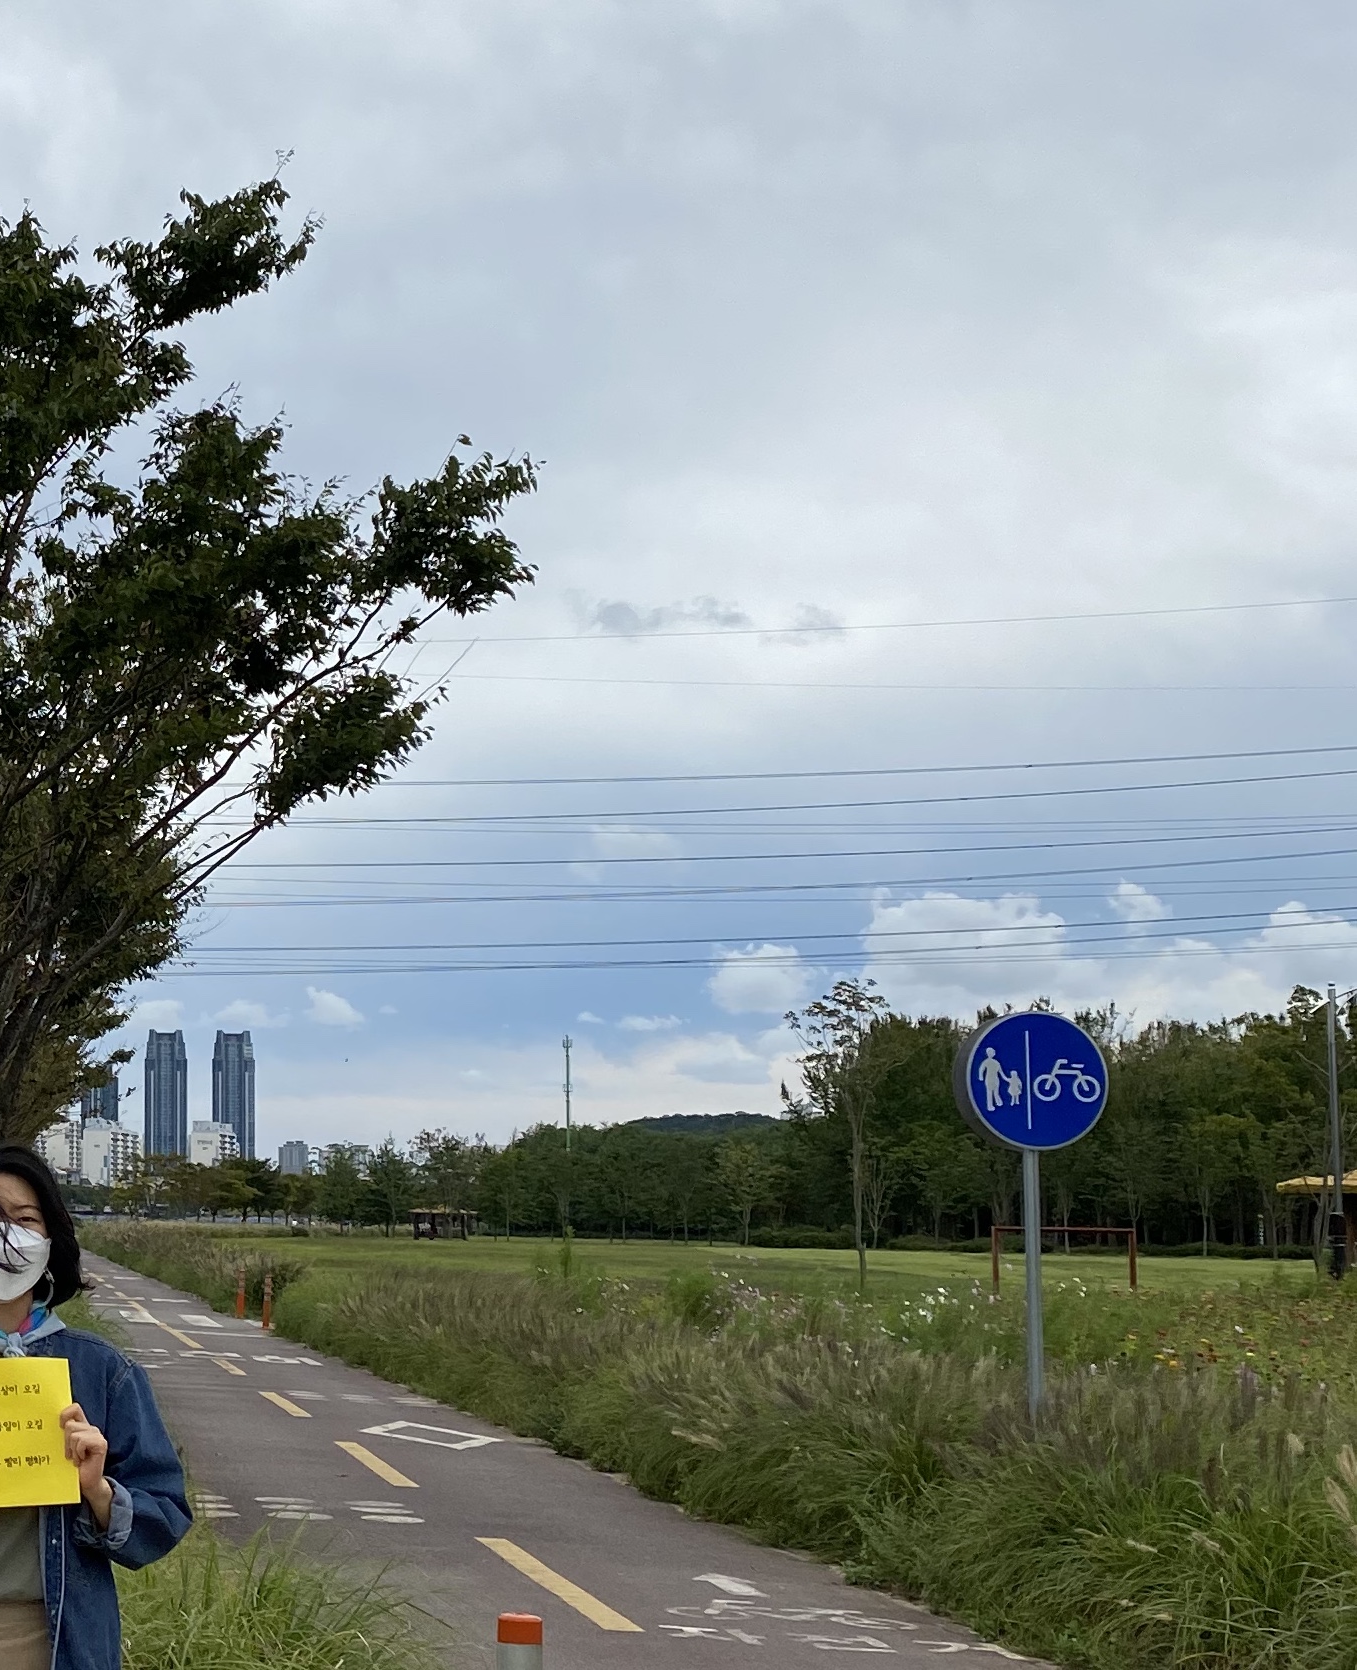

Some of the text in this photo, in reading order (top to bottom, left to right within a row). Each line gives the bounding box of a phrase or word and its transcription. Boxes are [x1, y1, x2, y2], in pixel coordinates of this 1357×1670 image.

[23, 1383, 40, 1394] 오길
[26, 1419, 43, 1430] 오길
[4, 1456, 21, 1467] 빨리
[25, 1455, 50, 1466] 평화가
